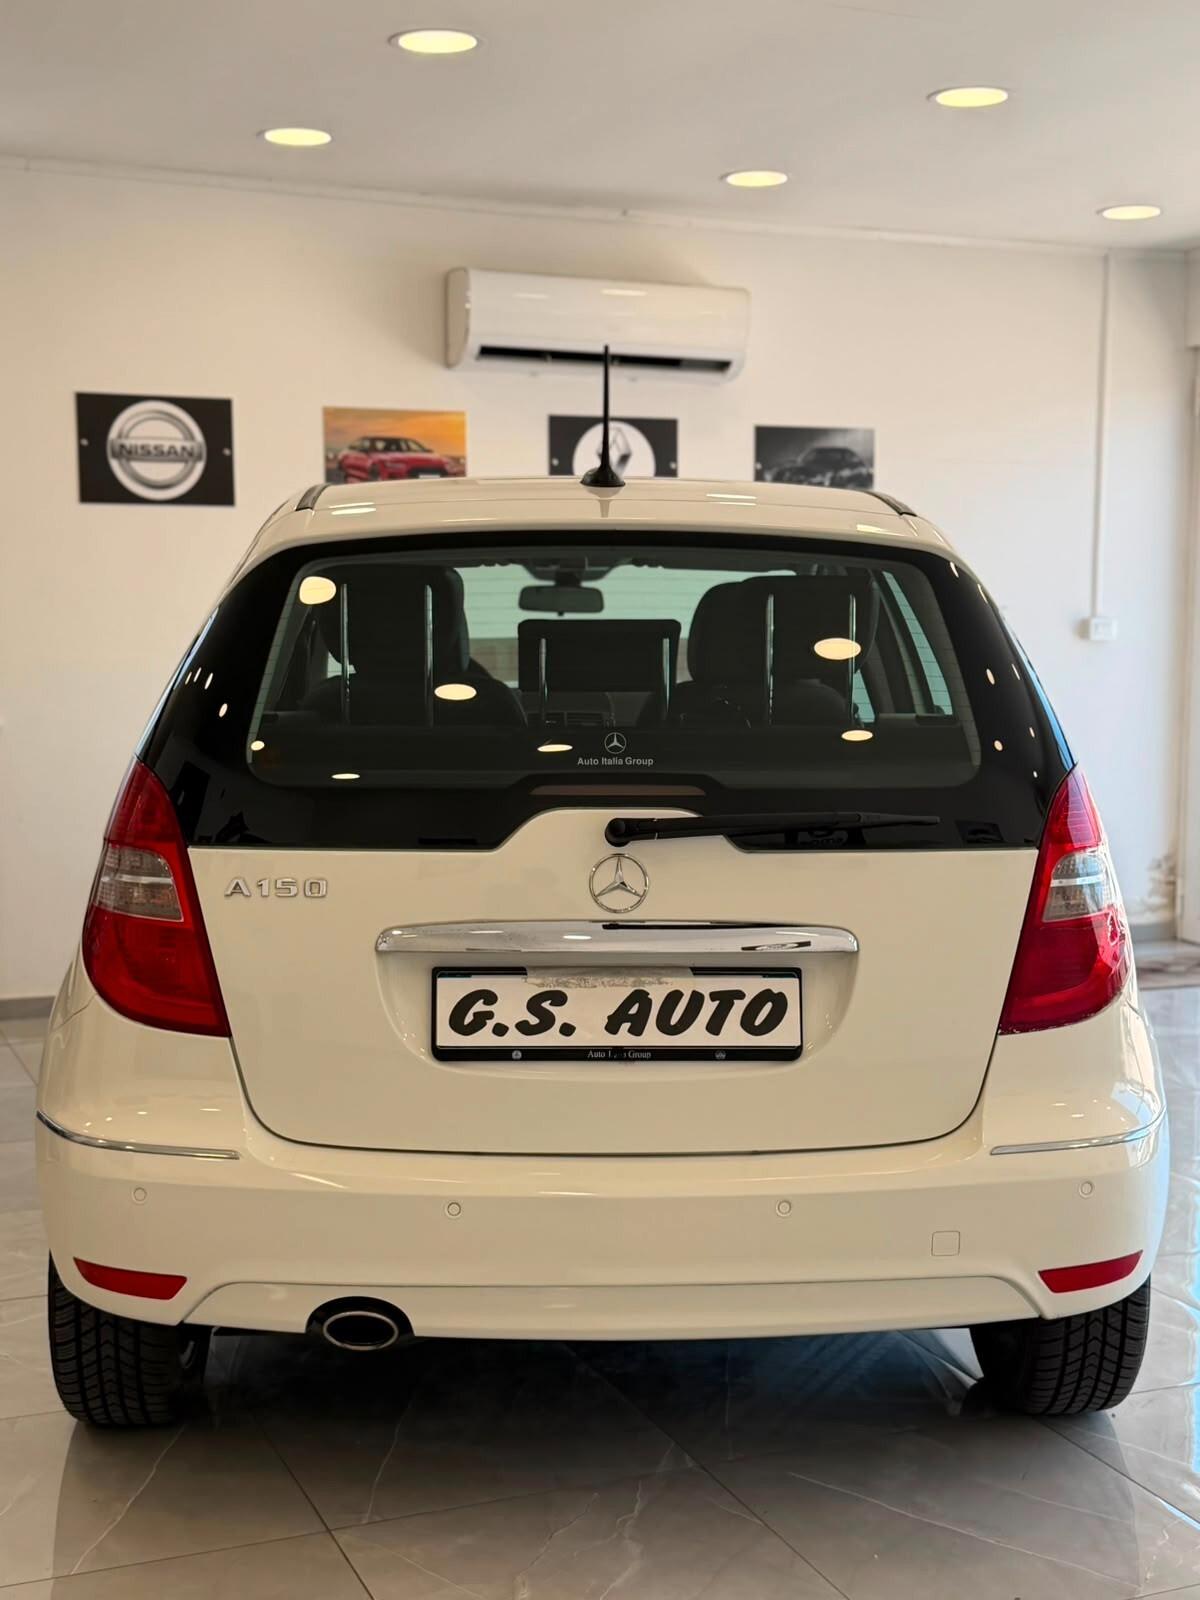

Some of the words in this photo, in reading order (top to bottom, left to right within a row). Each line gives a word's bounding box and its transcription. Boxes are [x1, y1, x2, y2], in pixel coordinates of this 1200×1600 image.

[119, 443, 194, 457] NISSAN
[577, 757, 599, 765] Auto
[601, 757, 623, 765] Italia
[625, 757, 654, 767] Group
[224, 877, 328, 898] A150
[448, 988, 576, 1037] G.S.
[604, 988, 789, 1037] AUTO
[587, 1050, 606, 1058] Auto
[628, 1050, 652, 1059] Group
